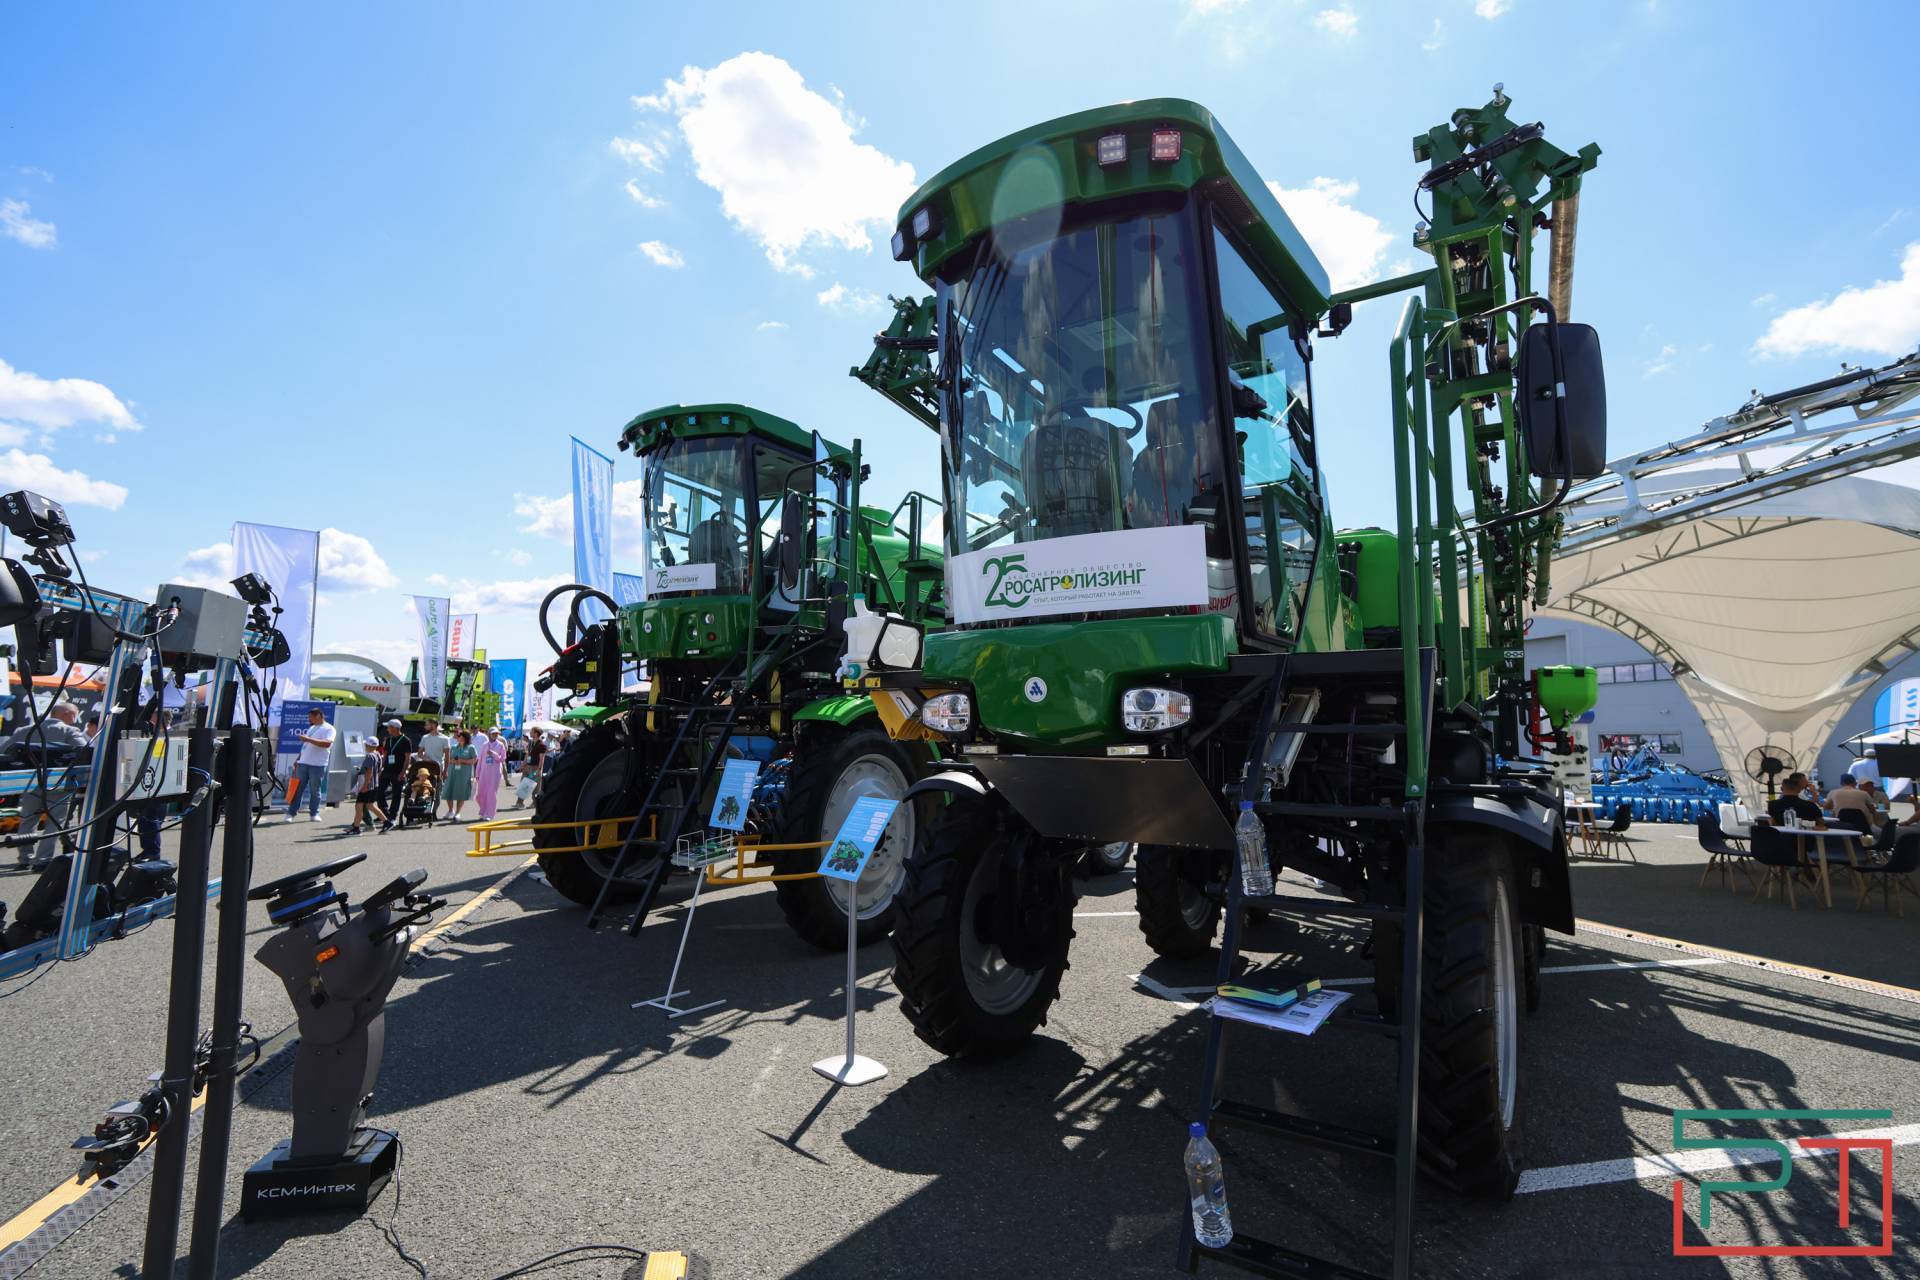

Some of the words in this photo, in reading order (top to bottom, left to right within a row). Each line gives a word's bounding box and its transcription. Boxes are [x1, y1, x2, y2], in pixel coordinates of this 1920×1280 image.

[1082, 562, 1142, 573] ОБЩЕСТВО
[982, 554, 1030, 608] 25
[1005, 568, 1146, 596] РОСАГРОЛИЗИНГ
[257, 1183, 356, 1199] КСМ-Интех
